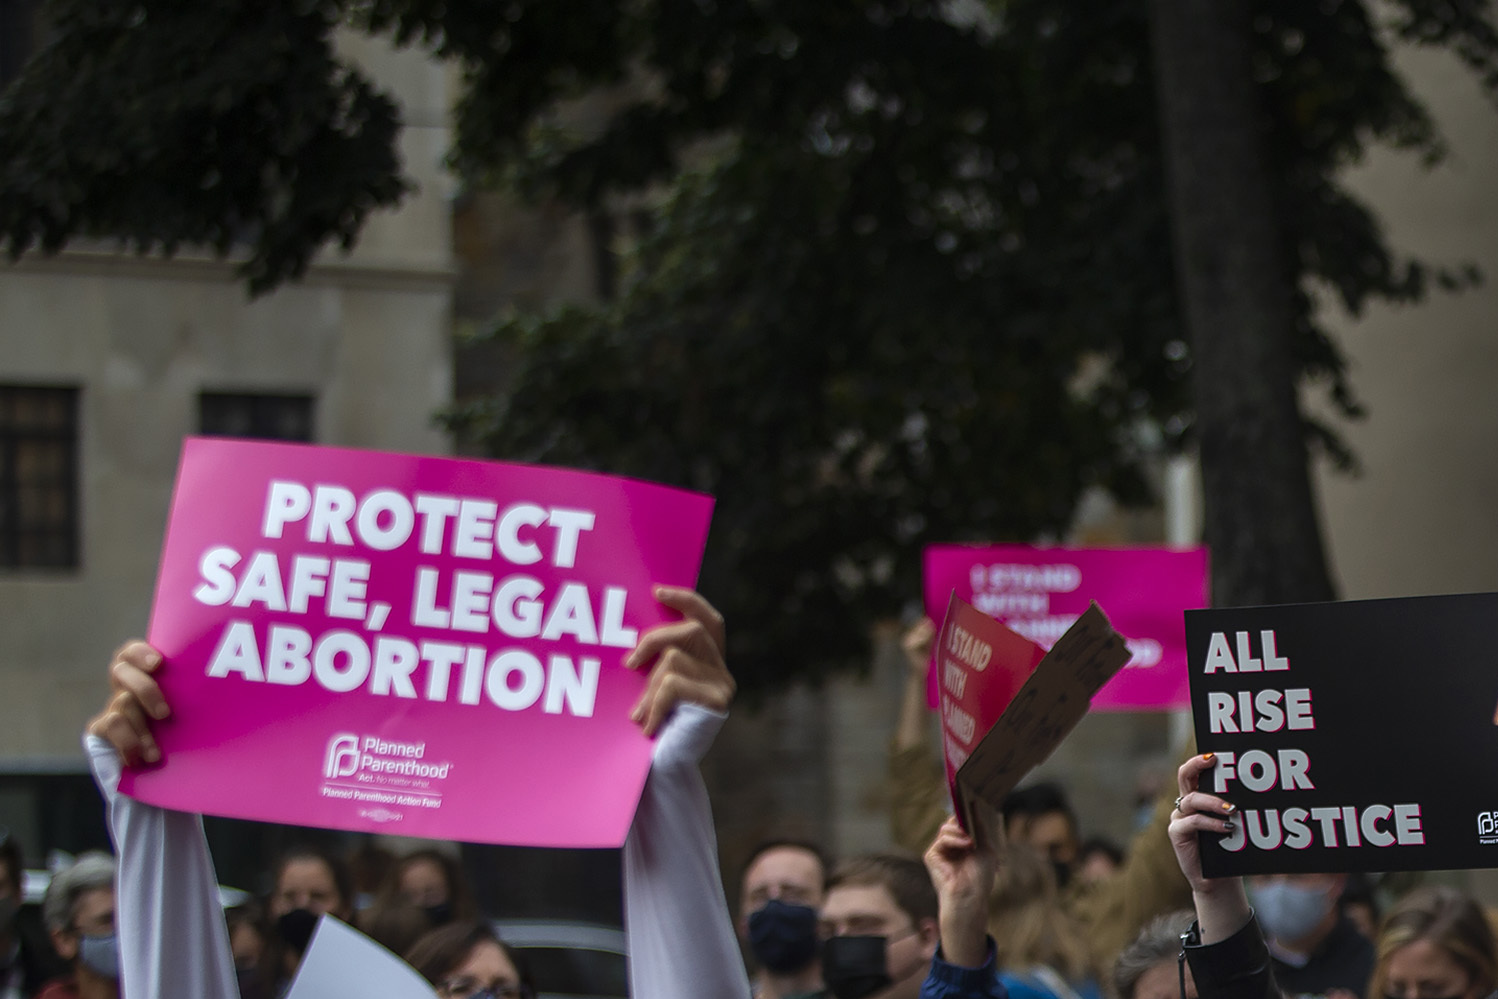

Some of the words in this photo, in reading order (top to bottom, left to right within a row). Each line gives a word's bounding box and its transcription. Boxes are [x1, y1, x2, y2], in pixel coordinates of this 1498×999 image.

[264, 480, 595, 568] PROTECT
[194, 547, 391, 631] SAFE,
[412, 566, 638, 649] LEGAL
[207, 622, 600, 718] ABORTION
[952, 626, 992, 672] STAND
[1204, 629, 1291, 674] ALL
[1209, 688, 1316, 734] RISE
[361, 755, 449, 779] Parenthood
[364, 737, 425, 759] Planned
[1213, 748, 1316, 793] FOR
[323, 788, 353, 800] Planned
[354, 790, 397, 804] Parenthood
[397, 796, 421, 807] Action
[421, 798, 442, 808] Fund
[1217, 803, 1426, 853] JUSTICE
